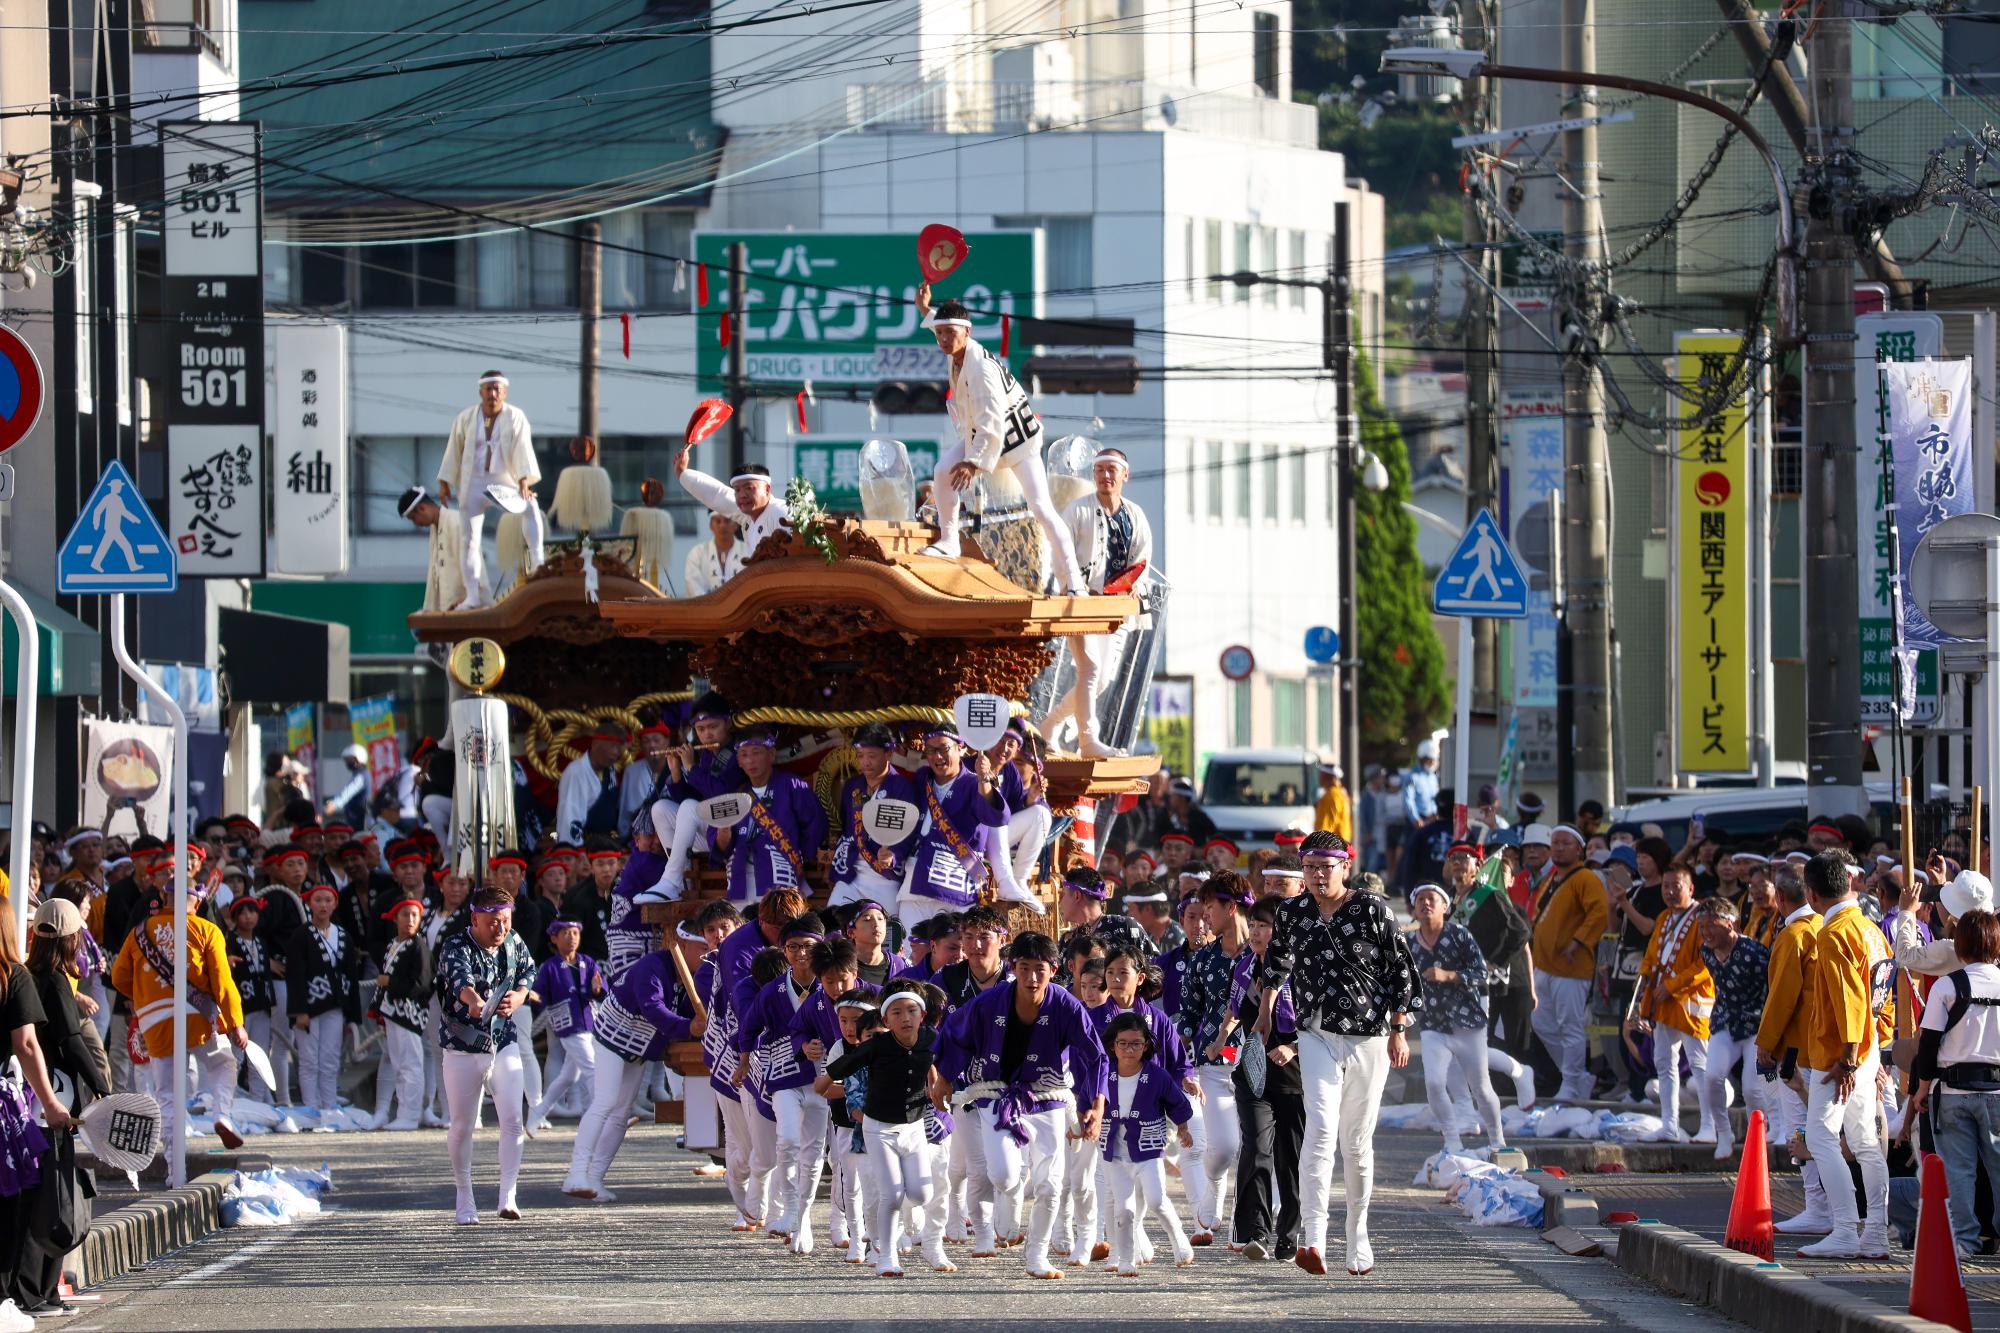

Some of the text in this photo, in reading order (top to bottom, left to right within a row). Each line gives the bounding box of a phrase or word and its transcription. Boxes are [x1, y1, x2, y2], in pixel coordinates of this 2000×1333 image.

[181, 189, 241, 213] 501
[190, 221, 230, 239] ビル
[180, 343, 246, 367] Room
[748, 354, 804, 377] DRUG
[181, 369, 247, 407] 501
[1699, 511, 1728, 756] 関西エアーサービス
